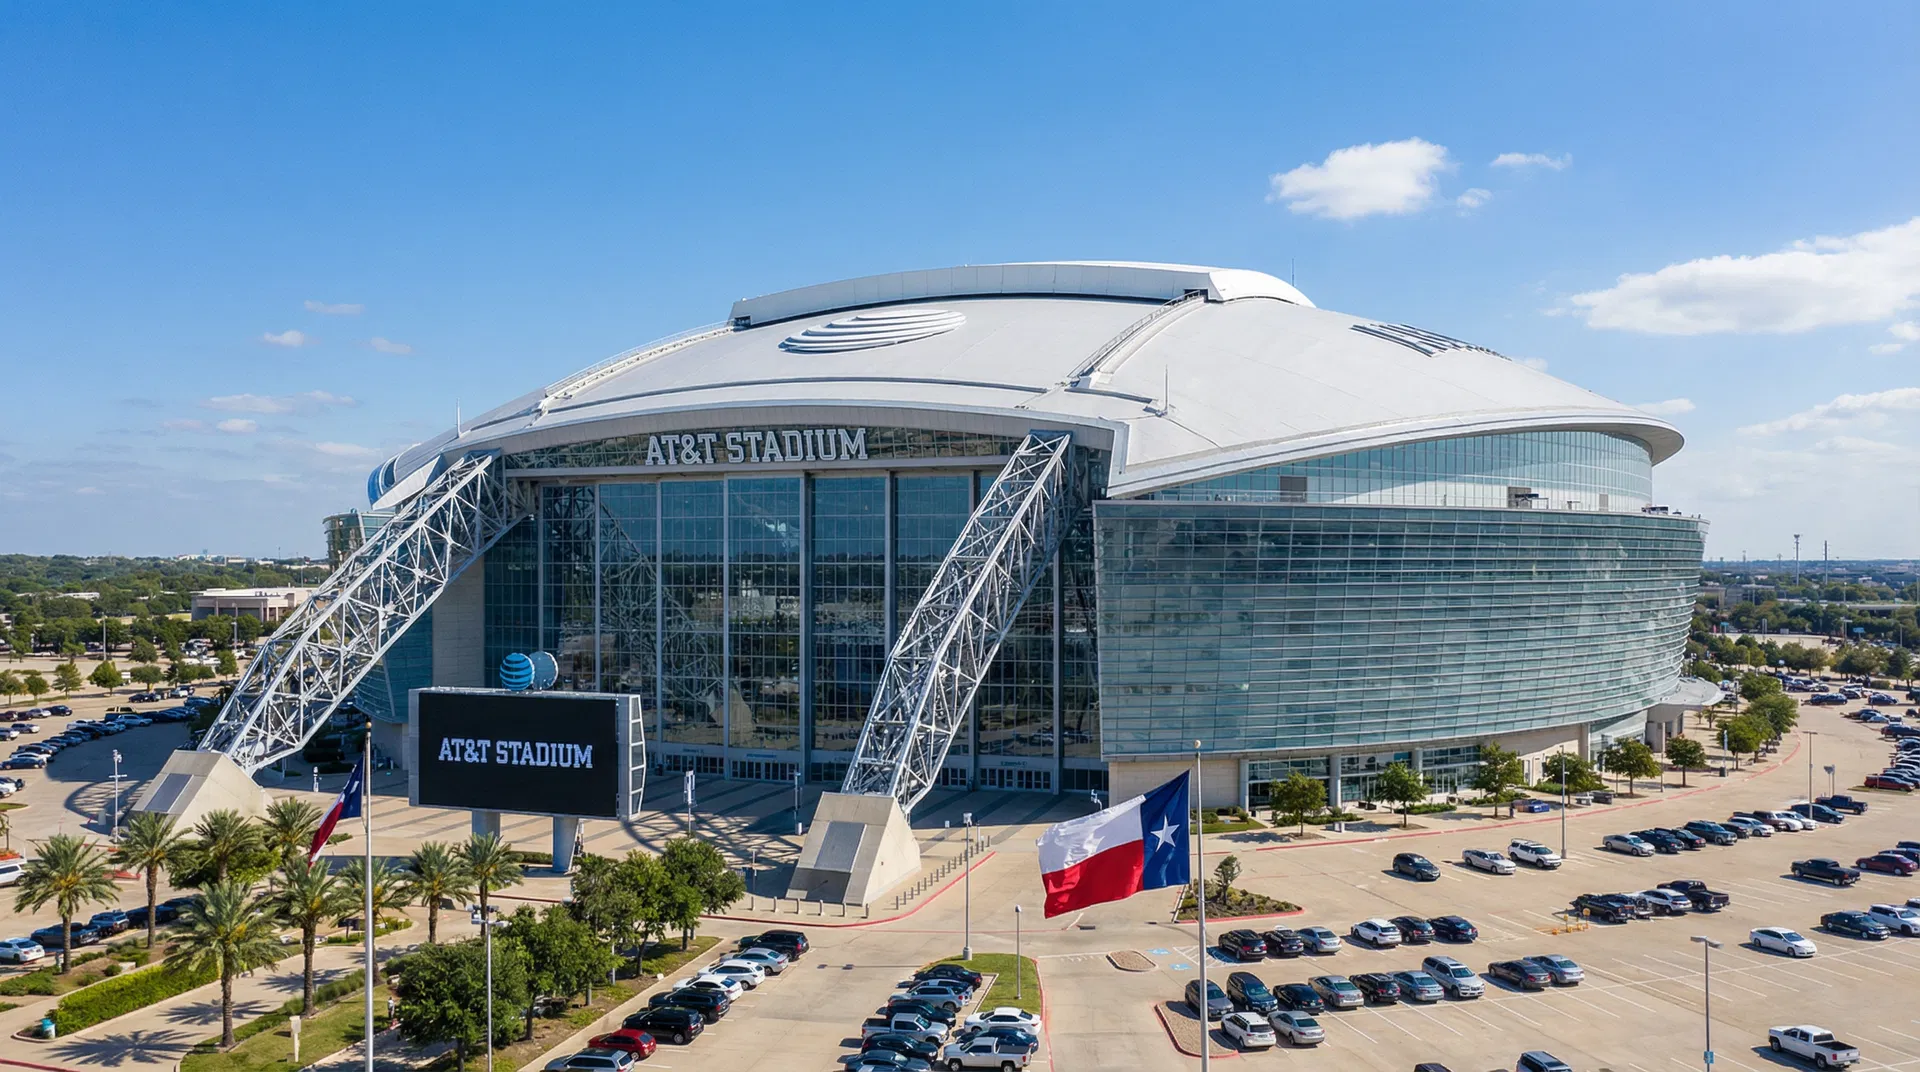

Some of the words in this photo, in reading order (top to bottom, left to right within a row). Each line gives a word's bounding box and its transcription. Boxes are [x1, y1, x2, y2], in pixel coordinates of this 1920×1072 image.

[645, 433, 717, 465] AT&T
[725, 427, 868, 464] STADIUM
[438, 737, 490, 763] AT&T
[496, 740, 593, 768] STADIUM
